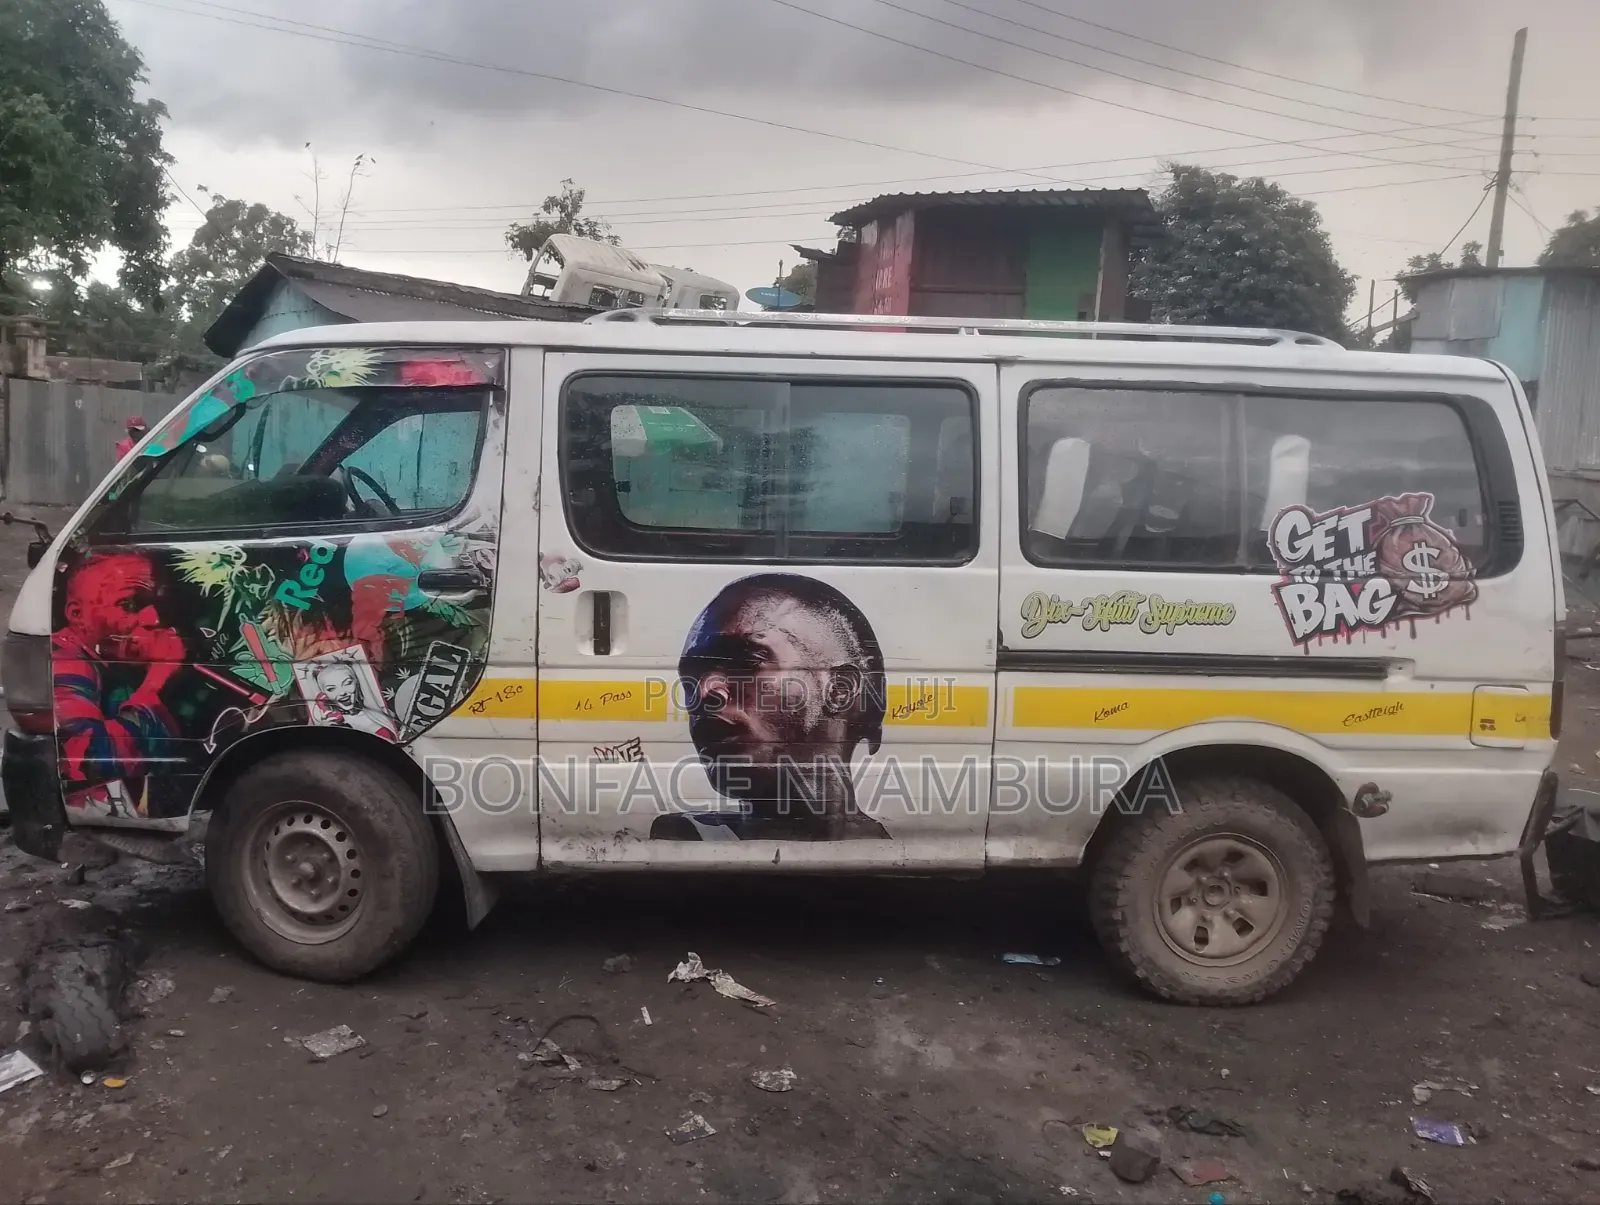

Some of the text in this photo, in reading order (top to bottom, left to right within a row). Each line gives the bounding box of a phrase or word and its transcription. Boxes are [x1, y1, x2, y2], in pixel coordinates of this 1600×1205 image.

[1274, 508, 1372, 563] GET
[1288, 550, 1379, 584] TO THE
[1139, 593, 1236, 635] Supreme
[1277, 578, 1398, 639] BAG
[600, 690, 633, 706] Pass
